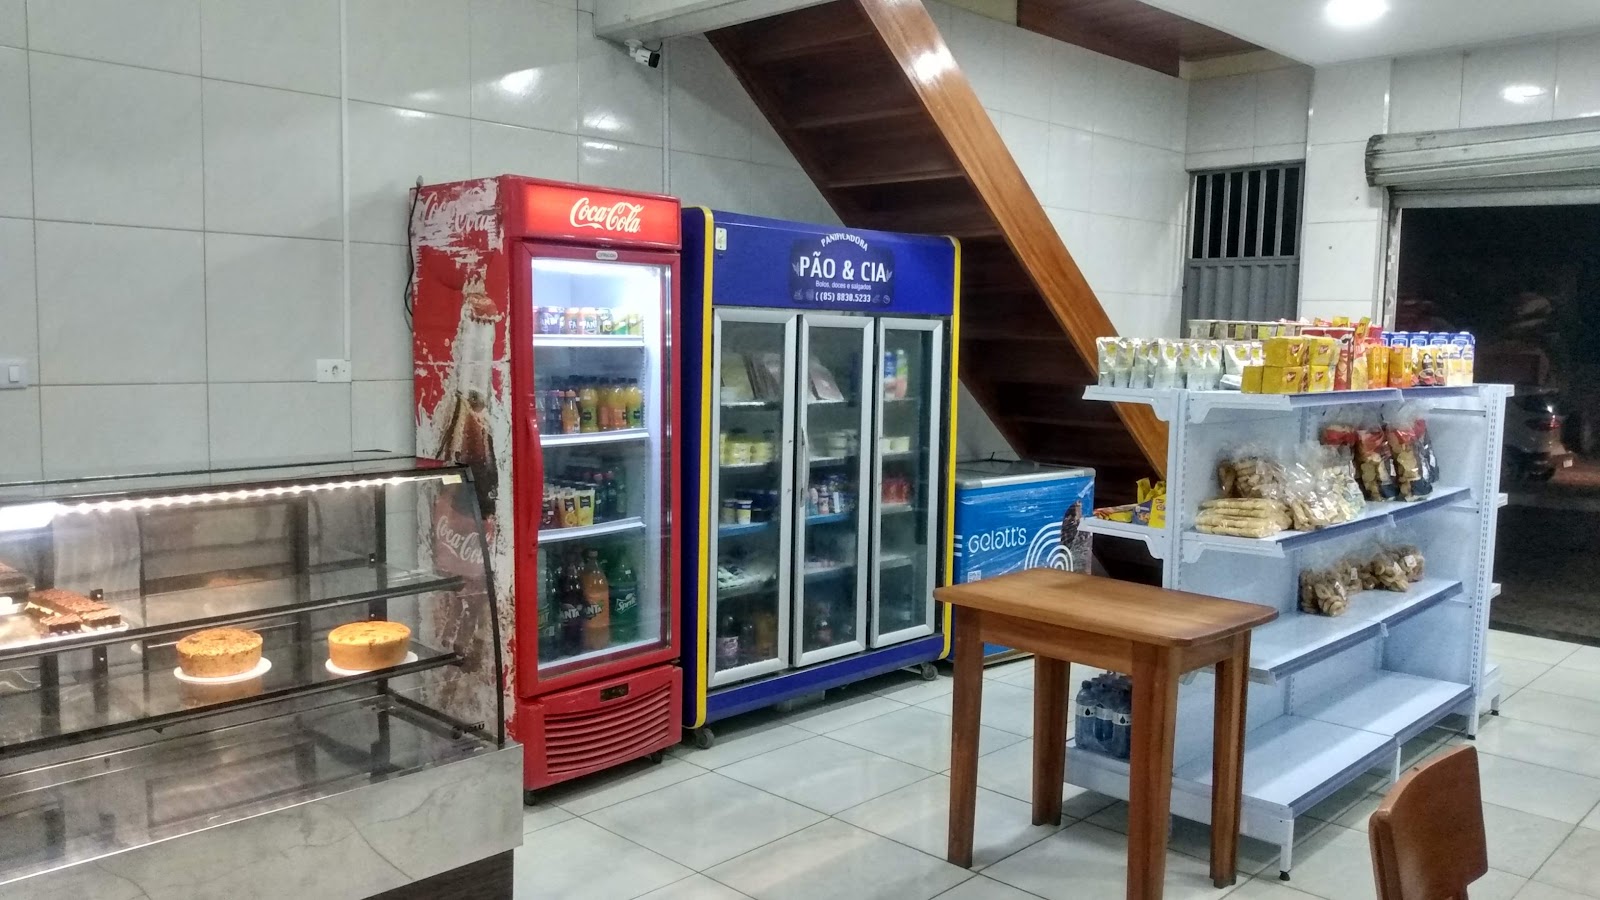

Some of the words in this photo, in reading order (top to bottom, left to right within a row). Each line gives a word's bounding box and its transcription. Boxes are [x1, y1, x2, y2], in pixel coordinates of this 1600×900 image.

[569, 197, 645, 234] Coca-Cola
[820, 232, 869, 252] PANIFICADORA
[799, 251, 836, 279] PÃO
[842, 260, 855, 281] &
[861, 261, 888, 283] CIA
[831, 281, 846, 289] doces
[851, 282, 872, 292] salgados
